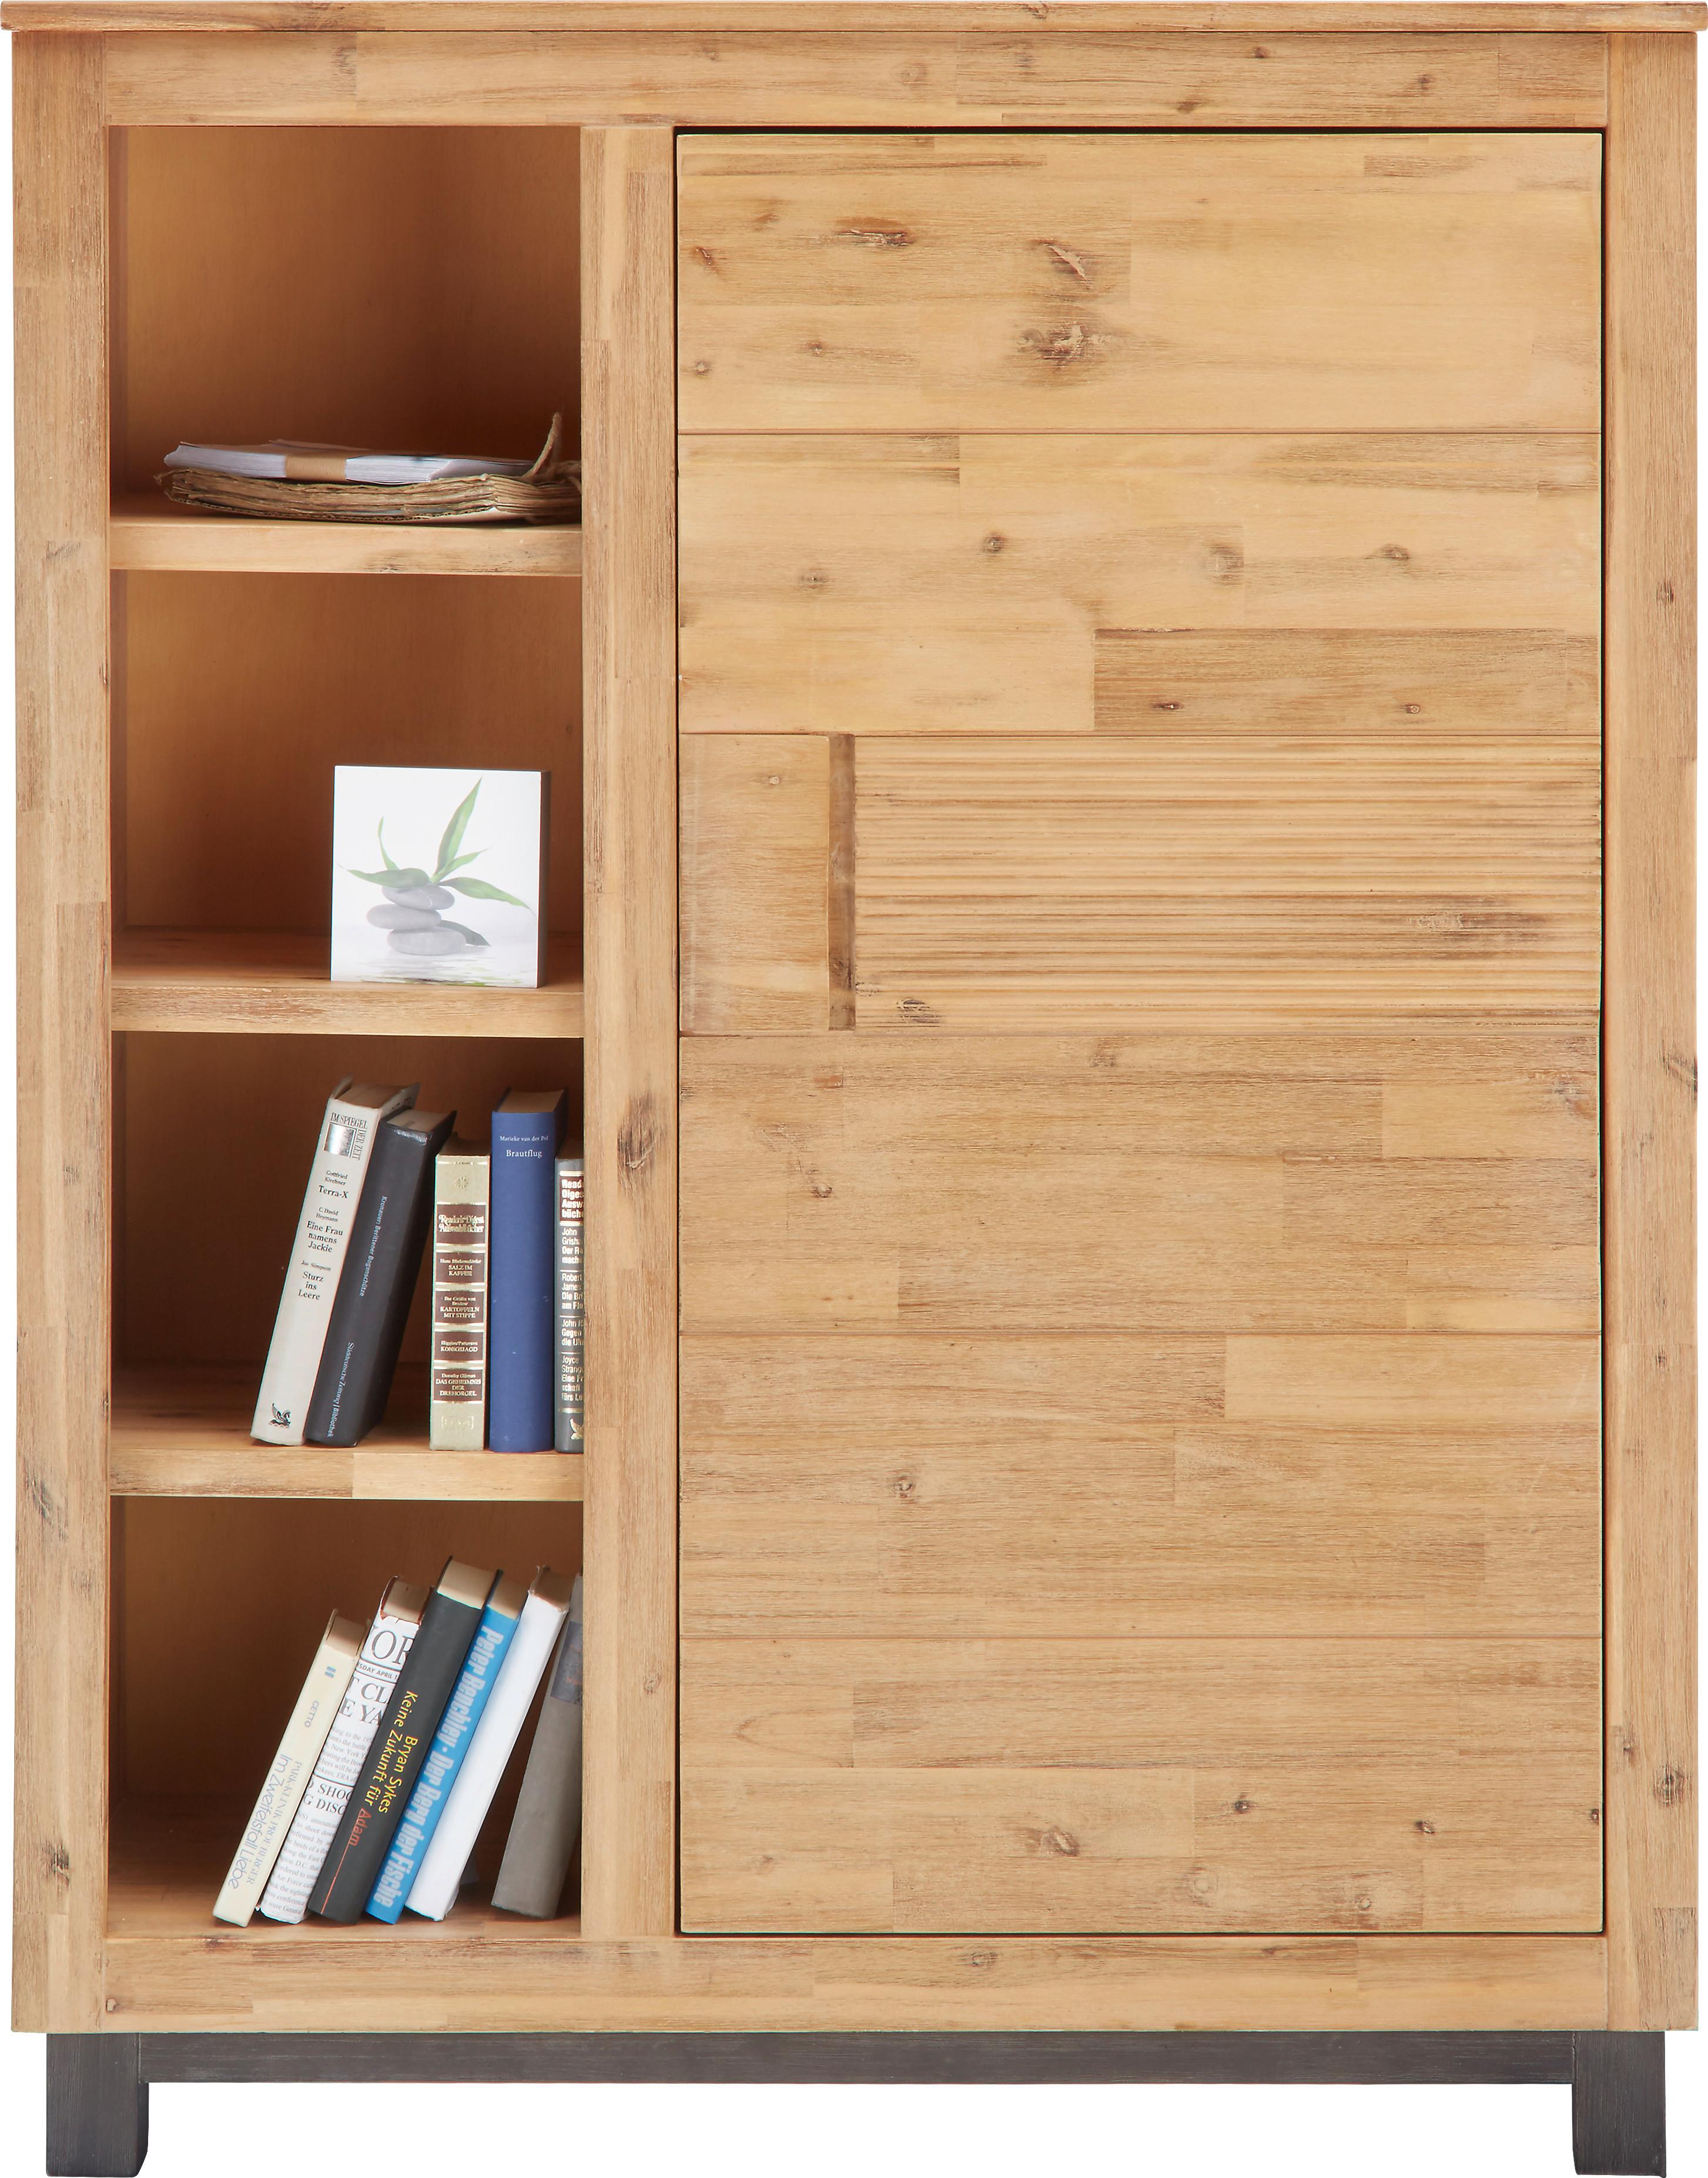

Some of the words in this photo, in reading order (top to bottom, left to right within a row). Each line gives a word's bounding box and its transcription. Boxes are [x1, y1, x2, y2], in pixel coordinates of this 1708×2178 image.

[330, 1112, 340, 1123] IM
[340, 1115, 367, 1129] SPIEGEL
[356, 1129, 367, 1143] DER
[352, 1145, 363, 1160] ZEIT
[506, 1149, 542, 1159] Brautflug
[326, 1170, 347, 1179] Gottfried
[324, 1177, 346, 1186] Kirchner
[319, 1185, 348, 1198] Terra-X
[316, 1213, 338, 1222] Heymann
[307, 1220, 323, 1232] Eine
[325, 1226, 343, 1236] Frau
[562, 1227, 577, 1236] John
[309, 1233, 337, 1244] namens
[308, 1241, 332, 1253] Jackie
[562, 1246, 574, 1254] Der
[310, 1263, 331, 1271] Simpson
[303, 1272, 323, 1282] Sturz
[306, 1282, 317, 1290] ins
[299, 1289, 320, 1300] Leere
[562, 1292, 572, 1300] Die
[562, 1302, 572, 1310] am
[562, 1319, 577, 1327] John
[562, 1328, 581, 1339] Gegen
[562, 1338, 571, 1346] die
[562, 1356, 579, 1365] Joyce
[562, 1374, 575, 1382] Eine
[327, 1407, 339, 1437] Bibliothek
[468, 1625, 504, 1677] Peter
[376, 1670, 393, 1679] APRIL
[304, 1700, 320, 1728] CETTO
[394, 1691, 418, 1727] Keine
[436, 1670, 486, 1752] Benchley
[373, 1729, 403, 1782] Zukunft
[393, 1735, 418, 1773] Bryan
[274, 1754, 293, 1772] Im
[423, 1749, 455, 1790] Der
[364, 1785, 381, 1806] für
[379, 1776, 403, 1814] Sykes
[404, 1782, 442, 1827] Berg
[244, 1773, 284, 1852] Zweifelsfall
[349, 1808, 372, 1848] Adam
[396, 1822, 424, 1859] der
[228, 1852, 252, 1890] Liebe
[373, 1851, 414, 1909] Fische
